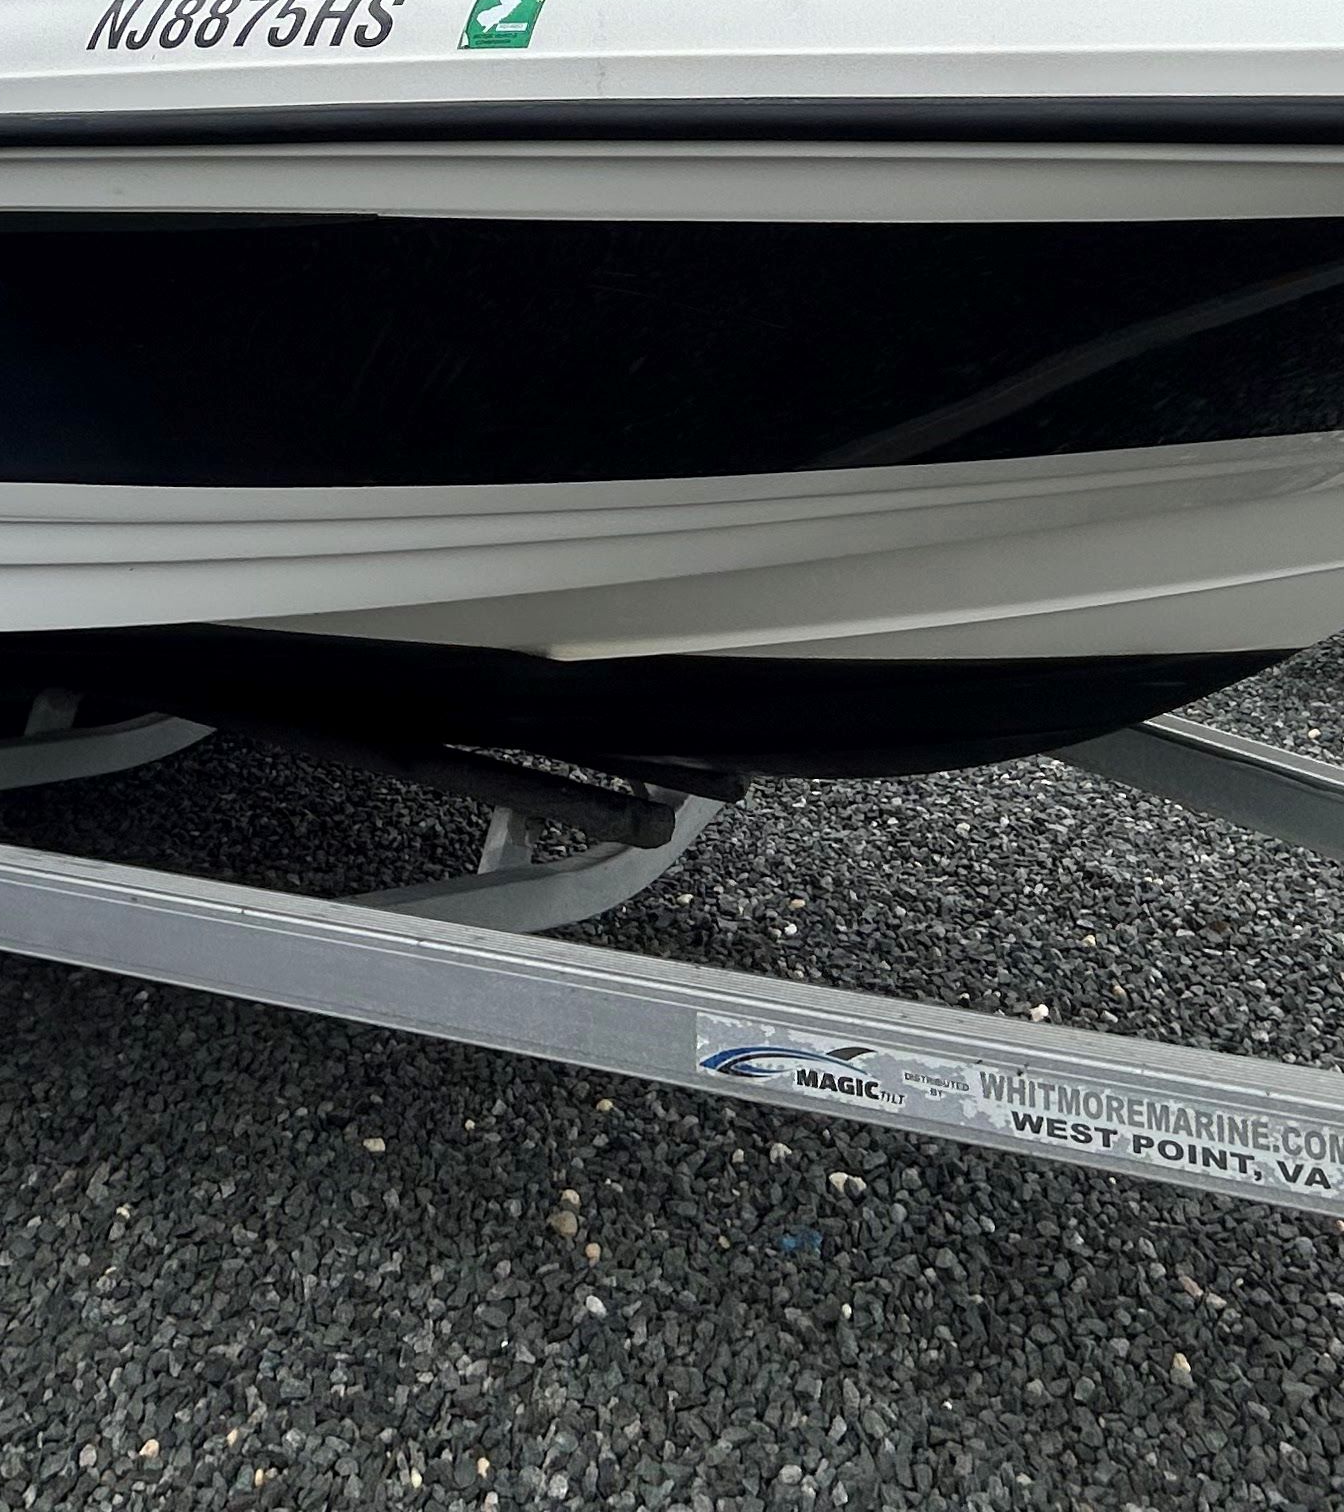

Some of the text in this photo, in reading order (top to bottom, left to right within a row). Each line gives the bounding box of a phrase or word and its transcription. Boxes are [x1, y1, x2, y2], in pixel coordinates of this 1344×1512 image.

[796, 1068, 880, 1100] MAGIC
[904, 1071, 970, 1092] DISTRIBUTED
[1011, 1110, 1332, 1190] WEST POINT, VA
